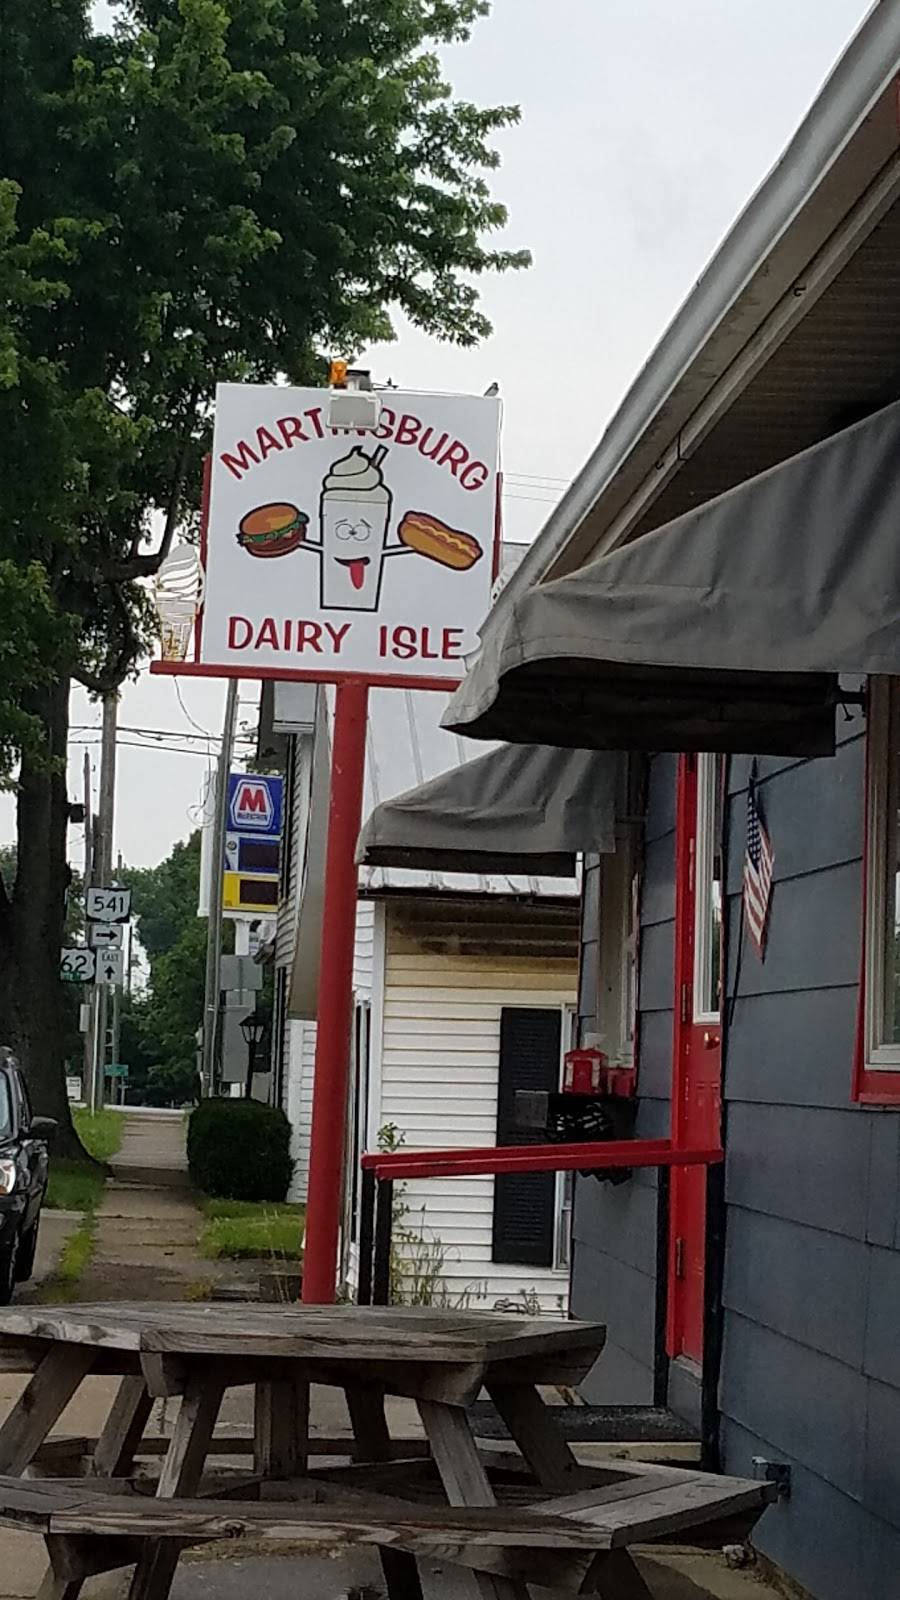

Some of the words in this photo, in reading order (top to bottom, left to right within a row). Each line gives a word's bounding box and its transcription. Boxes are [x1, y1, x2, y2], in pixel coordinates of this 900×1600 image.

[220, 407, 489, 490] MARTSBURG
[227, 616, 352, 653] DAIRY
[379, 625, 464, 659] ISLE
[239, 787, 267, 812] M
[93, 896, 124, 913] 541
[61, 954, 88, 975] 62
